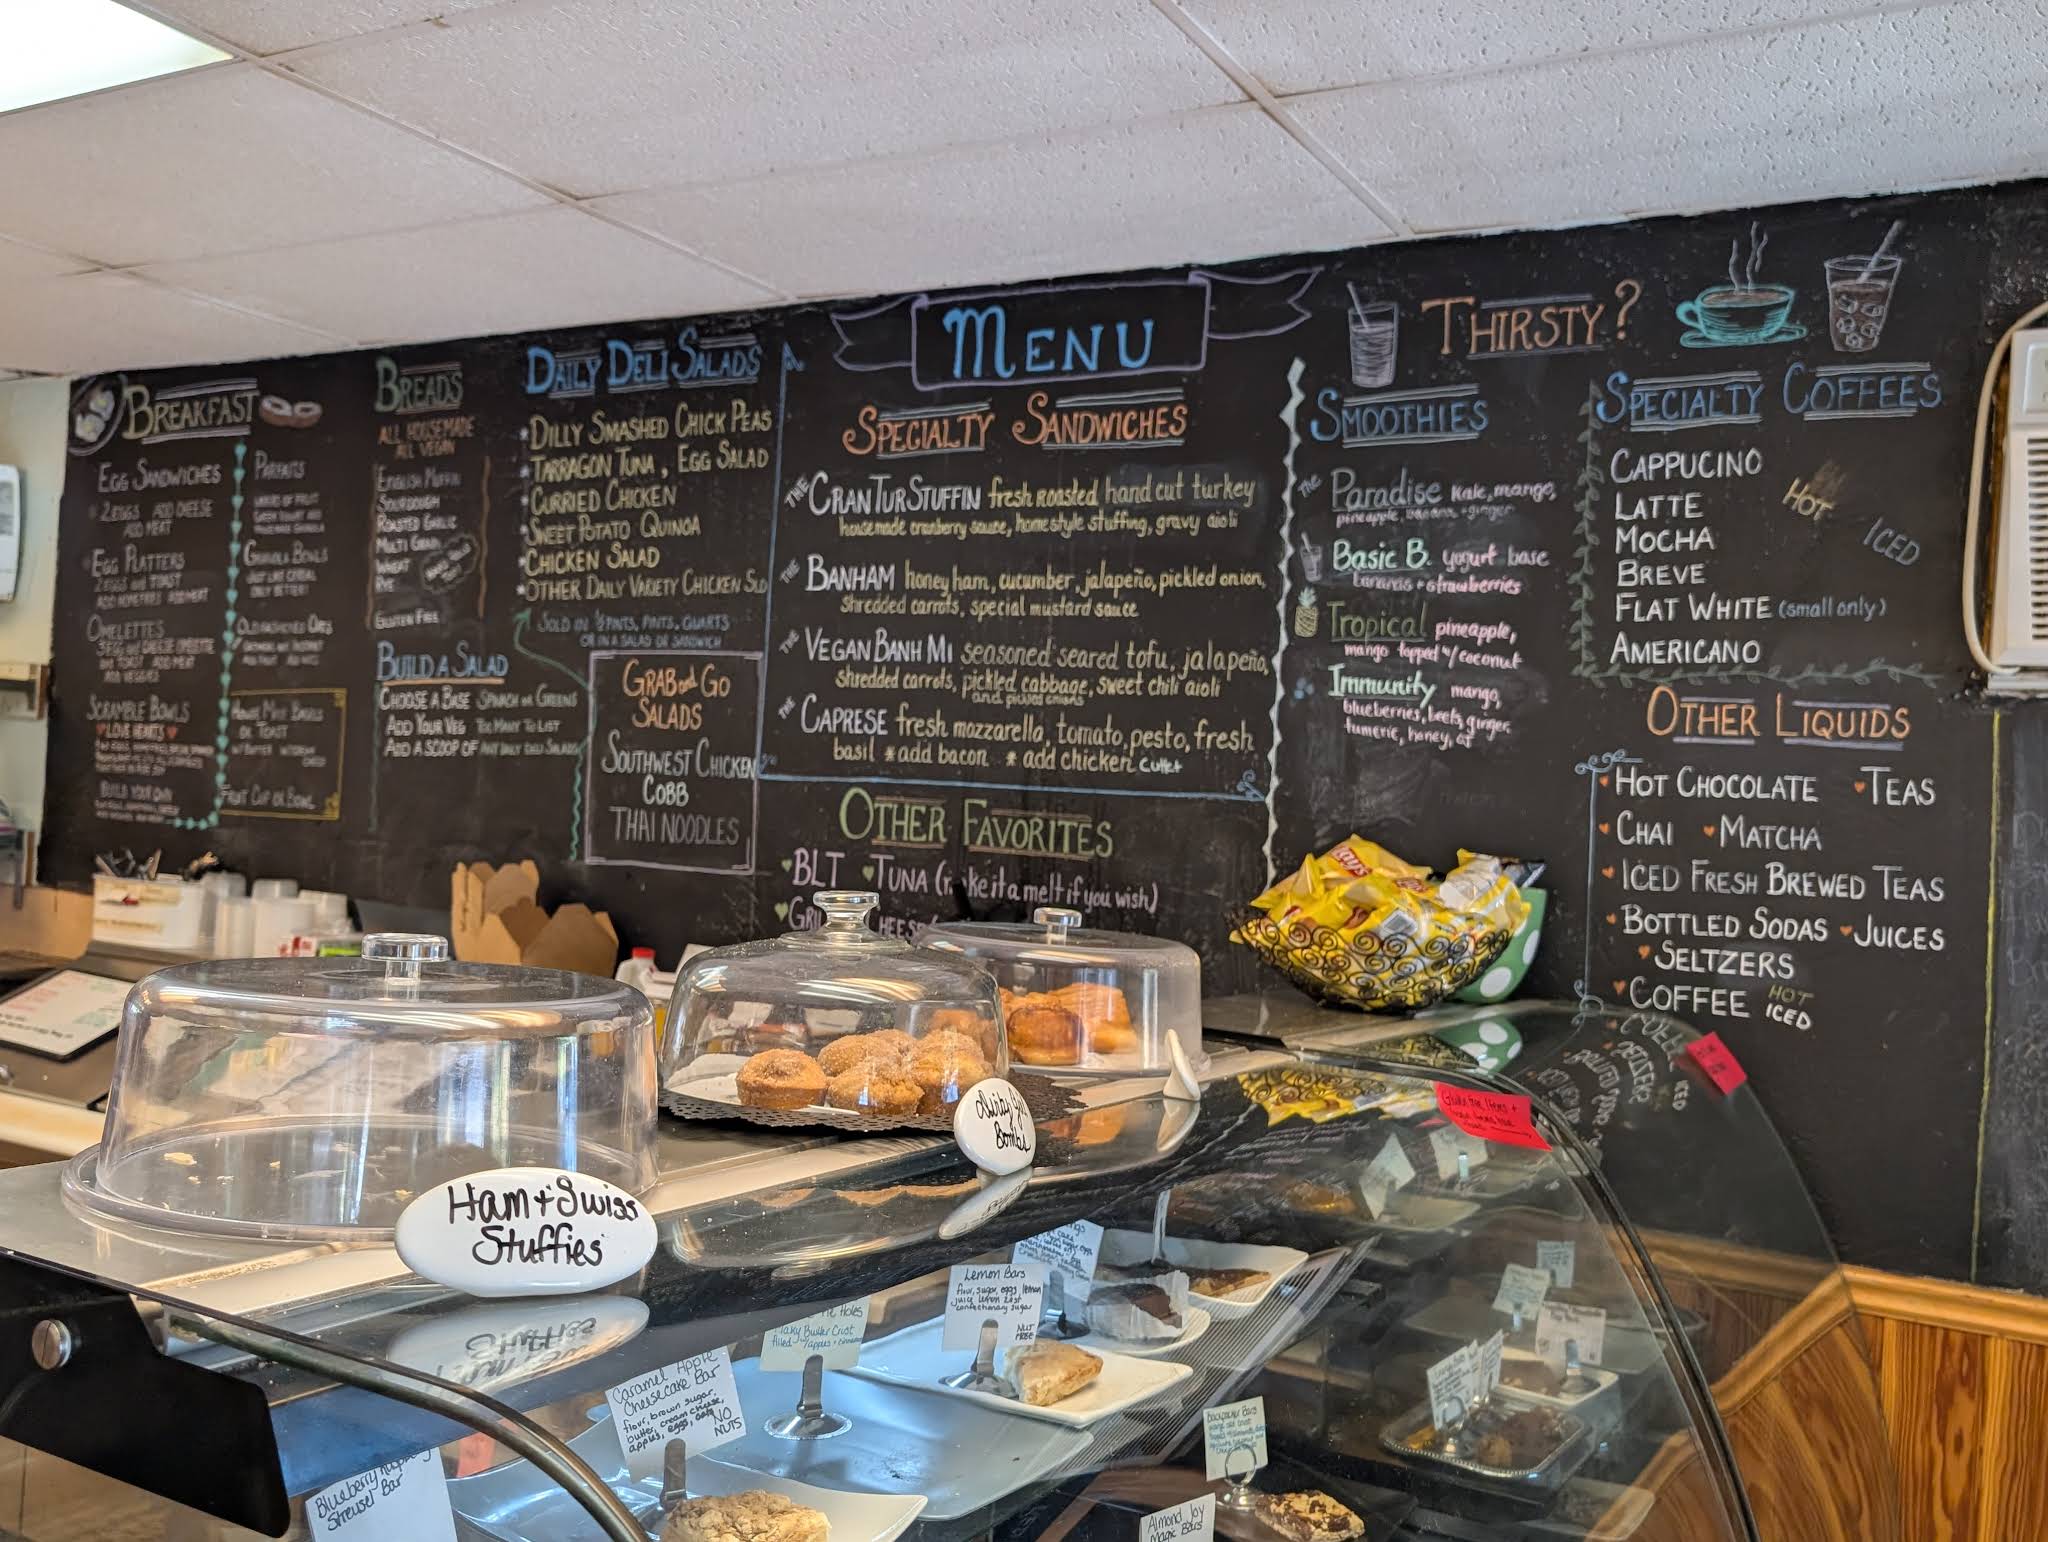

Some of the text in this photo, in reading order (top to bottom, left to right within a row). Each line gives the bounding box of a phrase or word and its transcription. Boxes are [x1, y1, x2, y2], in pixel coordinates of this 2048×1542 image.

[526, 327, 761, 394] DAILY DELI SALADS
[943, 304, 1154, 379] MENU
[375, 356, 464, 412] BREADS
[1597, 362, 1943, 424] SPECIALTY COFFEES
[121, 384, 260, 440] BREAKFAST
[529, 399, 772, 450] DILLY SMASHED CHICK PEAS
[842, 391, 1188, 455] SPECIALTY SANDWICHES
[1311, 388, 1489, 442] SMOOTHIES
[98, 461, 129, 493] EGG
[530, 439, 768, 483] TARRAGON EGG SALAD
[1611, 448, 1763, 484] CAPPUCINO
[530, 478, 677, 516] CURRIED CHICKEN
[987, 471, 1256, 509] fresh hand cut turkey
[1331, 468, 1442, 509] Paradise
[1615, 491, 1704, 522] LATTE
[1782, 476, 1838, 521] HOT
[526, 511, 700, 546] SWEET POTATO QUINOA
[1156, 509, 1238, 537] gravy aioli
[1615, 525, 1717, 554] MOCHA
[1863, 517, 1921, 566] ICED
[524, 541, 660, 577] CHICKEN SALAD
[1333, 539, 1550, 573] Basic yogurt base
[1616, 559, 1707, 587] BREVE
[525, 568, 741, 601] OTHER DAILY CHICKEN
[805, 553, 1217, 598] BANHAM honey pickled
[840, 594, 1138, 623] shredded special mustard sauce
[1327, 601, 1428, 645] Tropical
[1615, 592, 1773, 622] FLAT WHITE
[377, 640, 509, 680] BUILD A SALAD
[805, 626, 1119, 671] VEGAN BANH seasoned seared
[1344, 642, 1524, 670] mango topped coconut
[1610, 631, 1761, 665] AMERICANO
[622, 658, 731, 698] GRAB and GO
[835, 664, 1221, 699] shredded pickled sweet chili aioli
[1328, 663, 1437, 709] Immunity
[379, 686, 428, 711] CHOOSE
[632, 696, 702, 730] SALADS
[1646, 685, 1911, 740] OTHER LIQUIDS
[801, 692, 1254, 751] CAPRESE fresh fresh
[601, 729, 757, 781] SOUTHWEST CHICKEN
[833, 737, 1136, 773] basil bacon chicken
[642, 774, 689, 807] COBB
[1615, 765, 1819, 803] HOT CHOCOLATE
[1860, 766, 1936, 805] TEAS
[608, 806, 740, 846] THAI NOODLES
[839, 787, 1114, 858] OTHER FAVORITES
[1616, 809, 1673, 846] CHAI
[1720, 814, 1822, 852] MATCHA
[792, 847, 846, 888] BLT
[869, 853, 1112, 913] TUNA melt if you
[1622, 858, 1945, 902] ICED FRESH BREWED TEAS
[1621, 904, 1829, 942] BOTTLED SODAS
[1853, 913, 1945, 952] JUICES
[1654, 940, 1795, 980] SELTZERS
[1629, 976, 1814, 1018] COFFEE HOT
[1765, 1003, 1813, 1030] ICED
[448, 1175, 639, 1224] Ham Swiss
[472, 1224, 604, 1267] Stuffies
[964, 1265, 1026, 1281] Lemon Bars
[831, 1324, 855, 1337] Crust
[612, 1368, 668, 1404] Caramel
[694, 1364, 720, 1385] Bar
[650, 1403, 681, 1421] brown
[660, 1412, 688, 1428] cream
[712, 1406, 732, 1425] NO
[714, 1417, 742, 1437] NUTS
[315, 1469, 379, 1519] Blueberry
[327, 1474, 403, 1531] Streusel Bar
[1148, 1509, 1183, 1535] Almond
[1181, 1519, 1203, 1535] Bars
